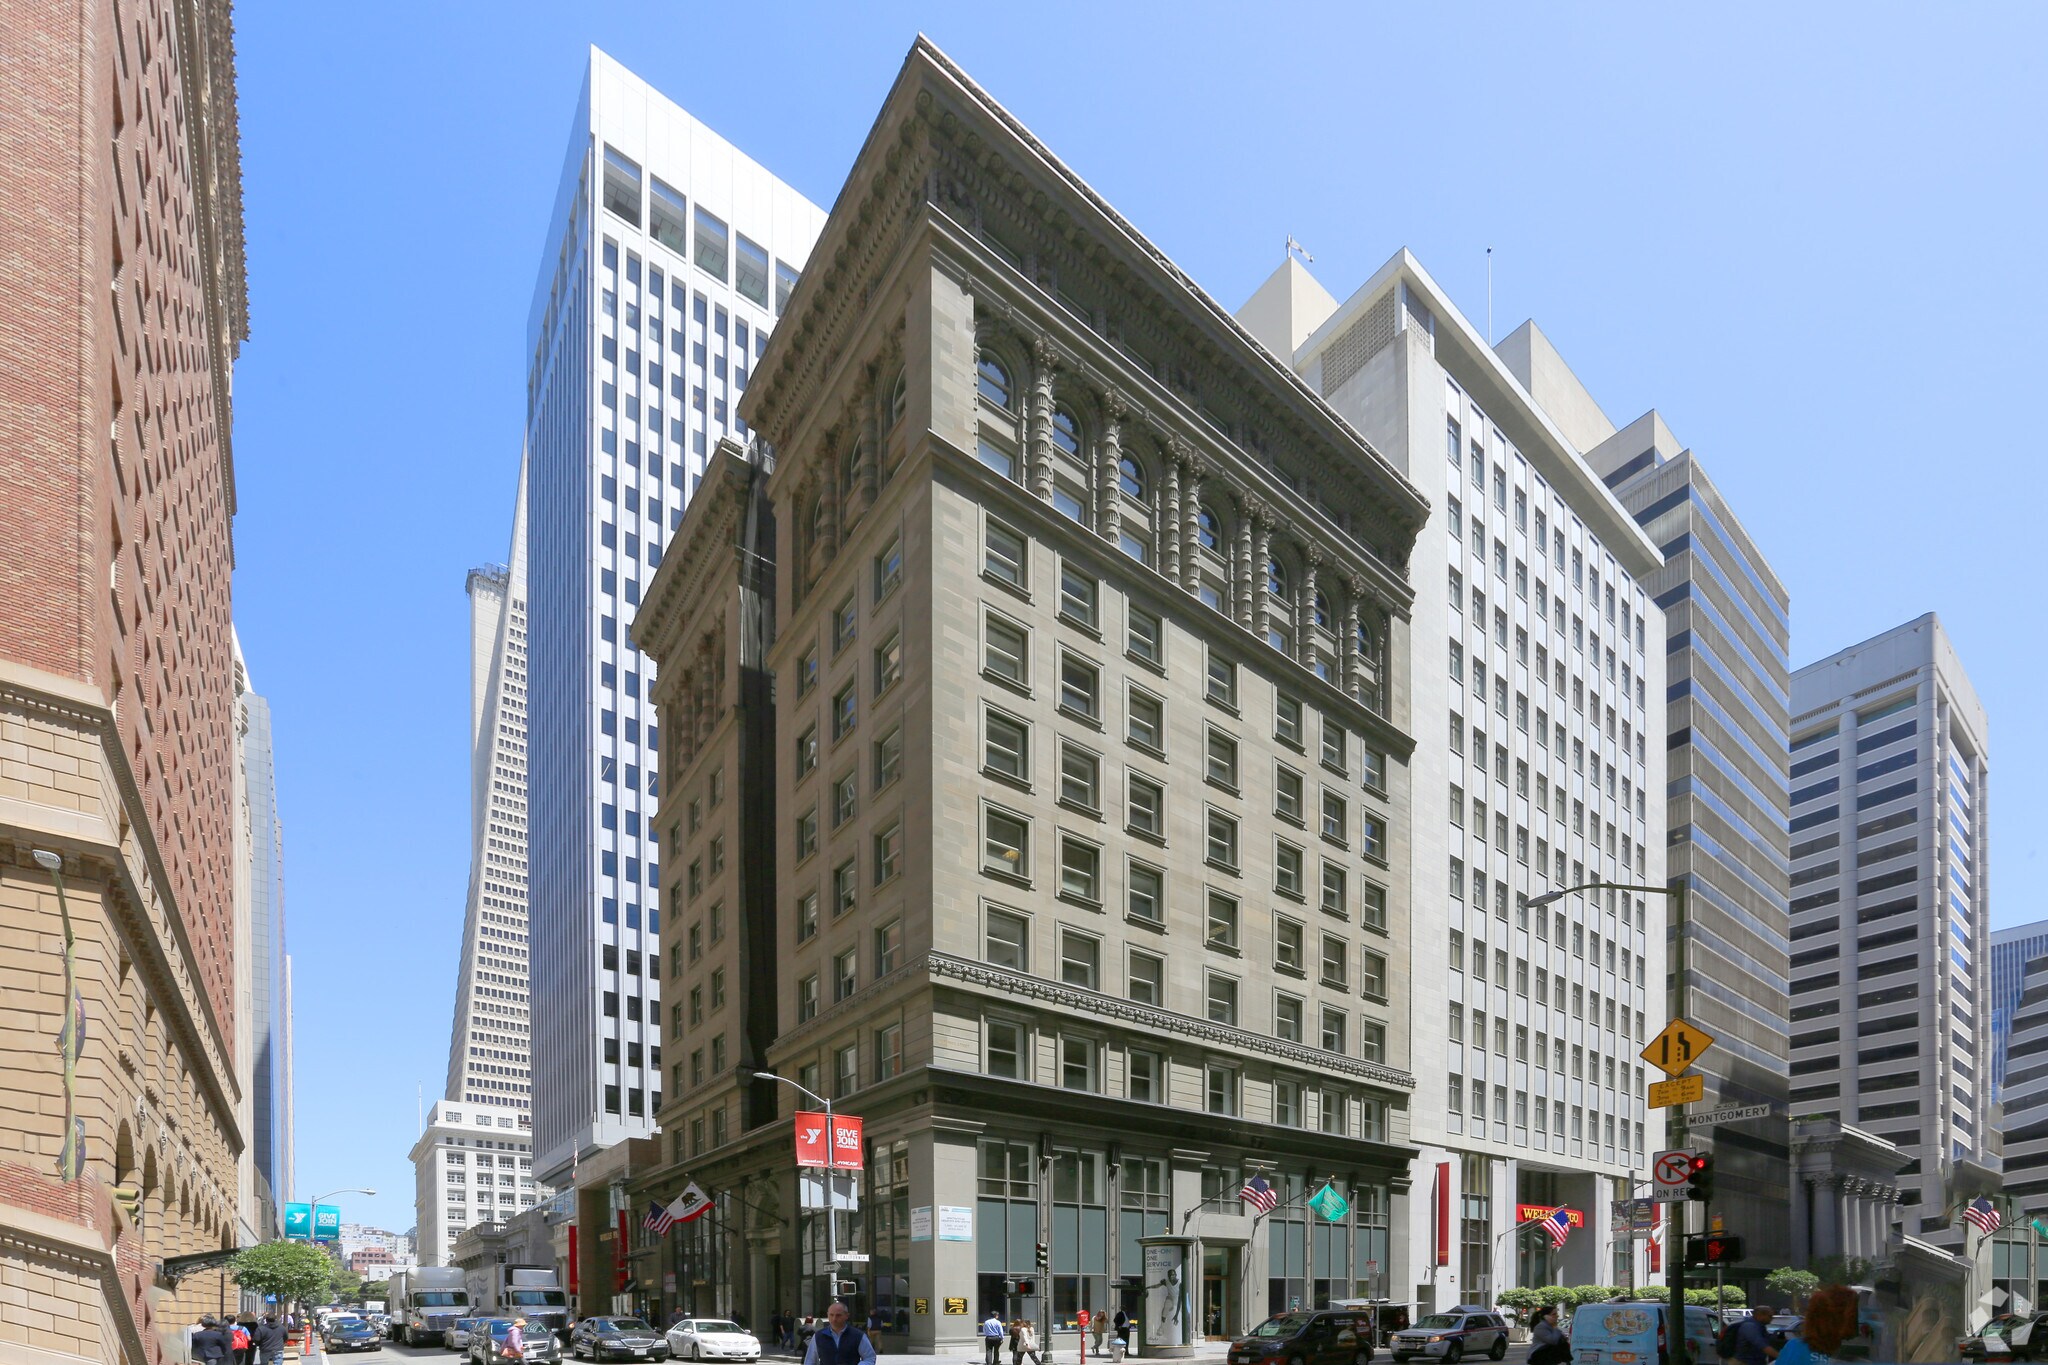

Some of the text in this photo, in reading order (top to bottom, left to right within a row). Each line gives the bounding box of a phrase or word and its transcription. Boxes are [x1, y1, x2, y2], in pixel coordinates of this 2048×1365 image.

[1660, 1079, 1692, 1089] EXCEPT
[1689, 1106, 1767, 1125] MONTGOMERY
[836, 1128, 858, 1138] GIVE
[836, 1136, 858, 1146] JOIN
[1656, 1189, 1670, 1198] ON
[317, 1212, 337, 1220] GIVE
